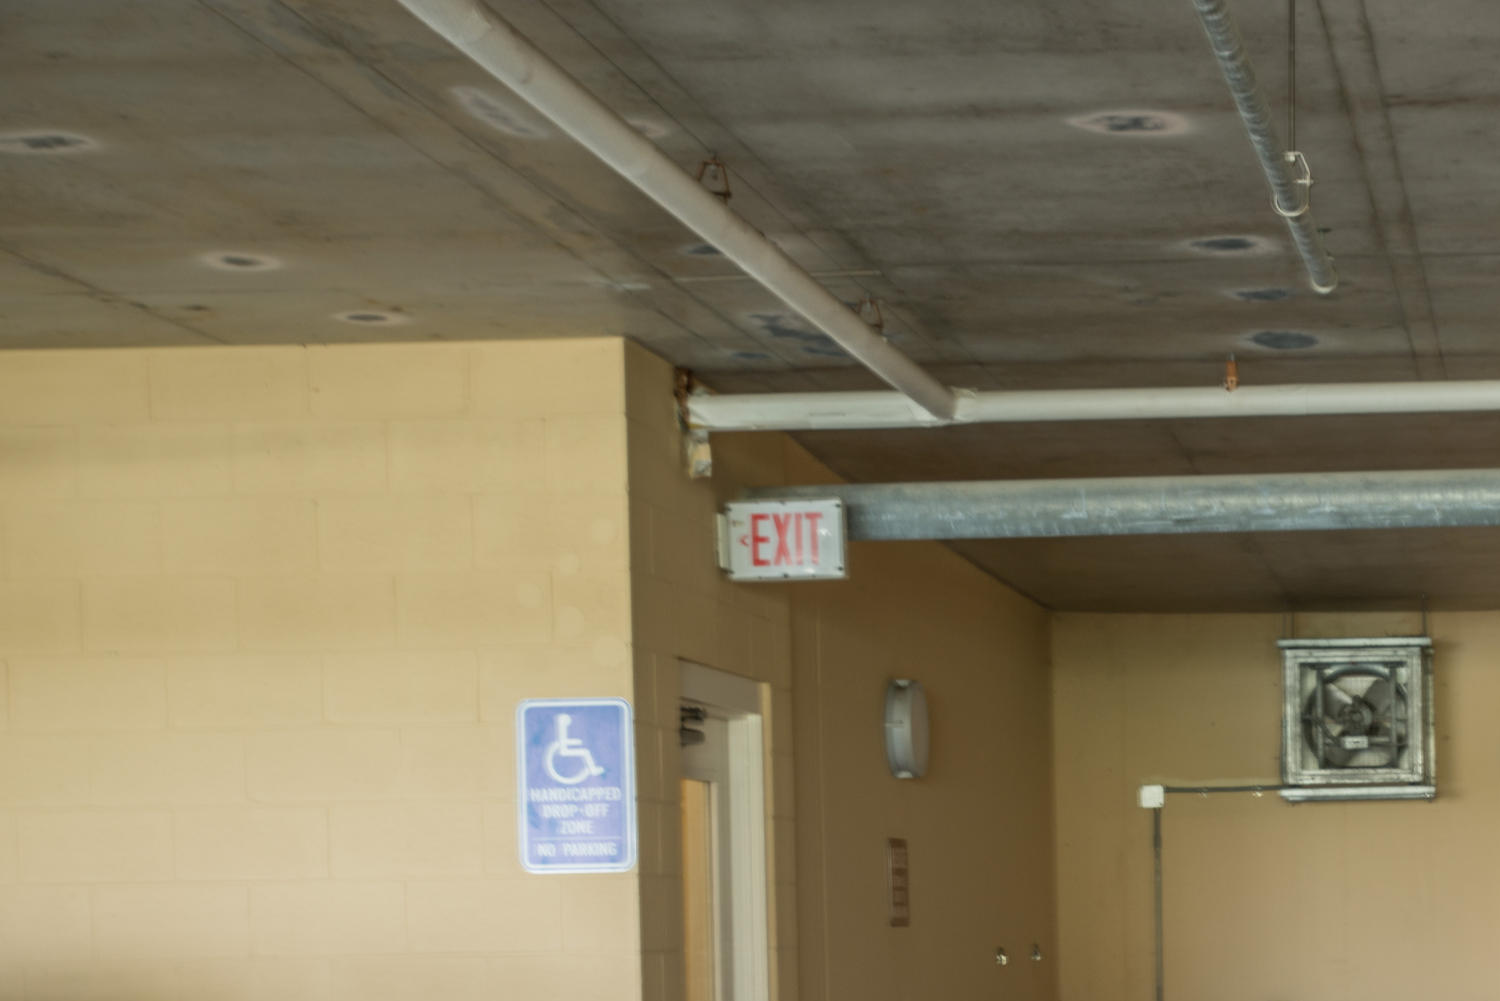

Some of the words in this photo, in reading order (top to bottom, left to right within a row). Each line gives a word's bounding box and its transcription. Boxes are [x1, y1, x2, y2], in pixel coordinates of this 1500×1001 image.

[751, 512, 823, 567] EXIT
[530, 787, 621, 802] HANDICAPPED
[541, 803, 609, 818] DROP-OFF
[560, 820, 594, 834] ZONE
[537, 843, 556, 857] NO
[562, 842, 617, 856] PARKING
